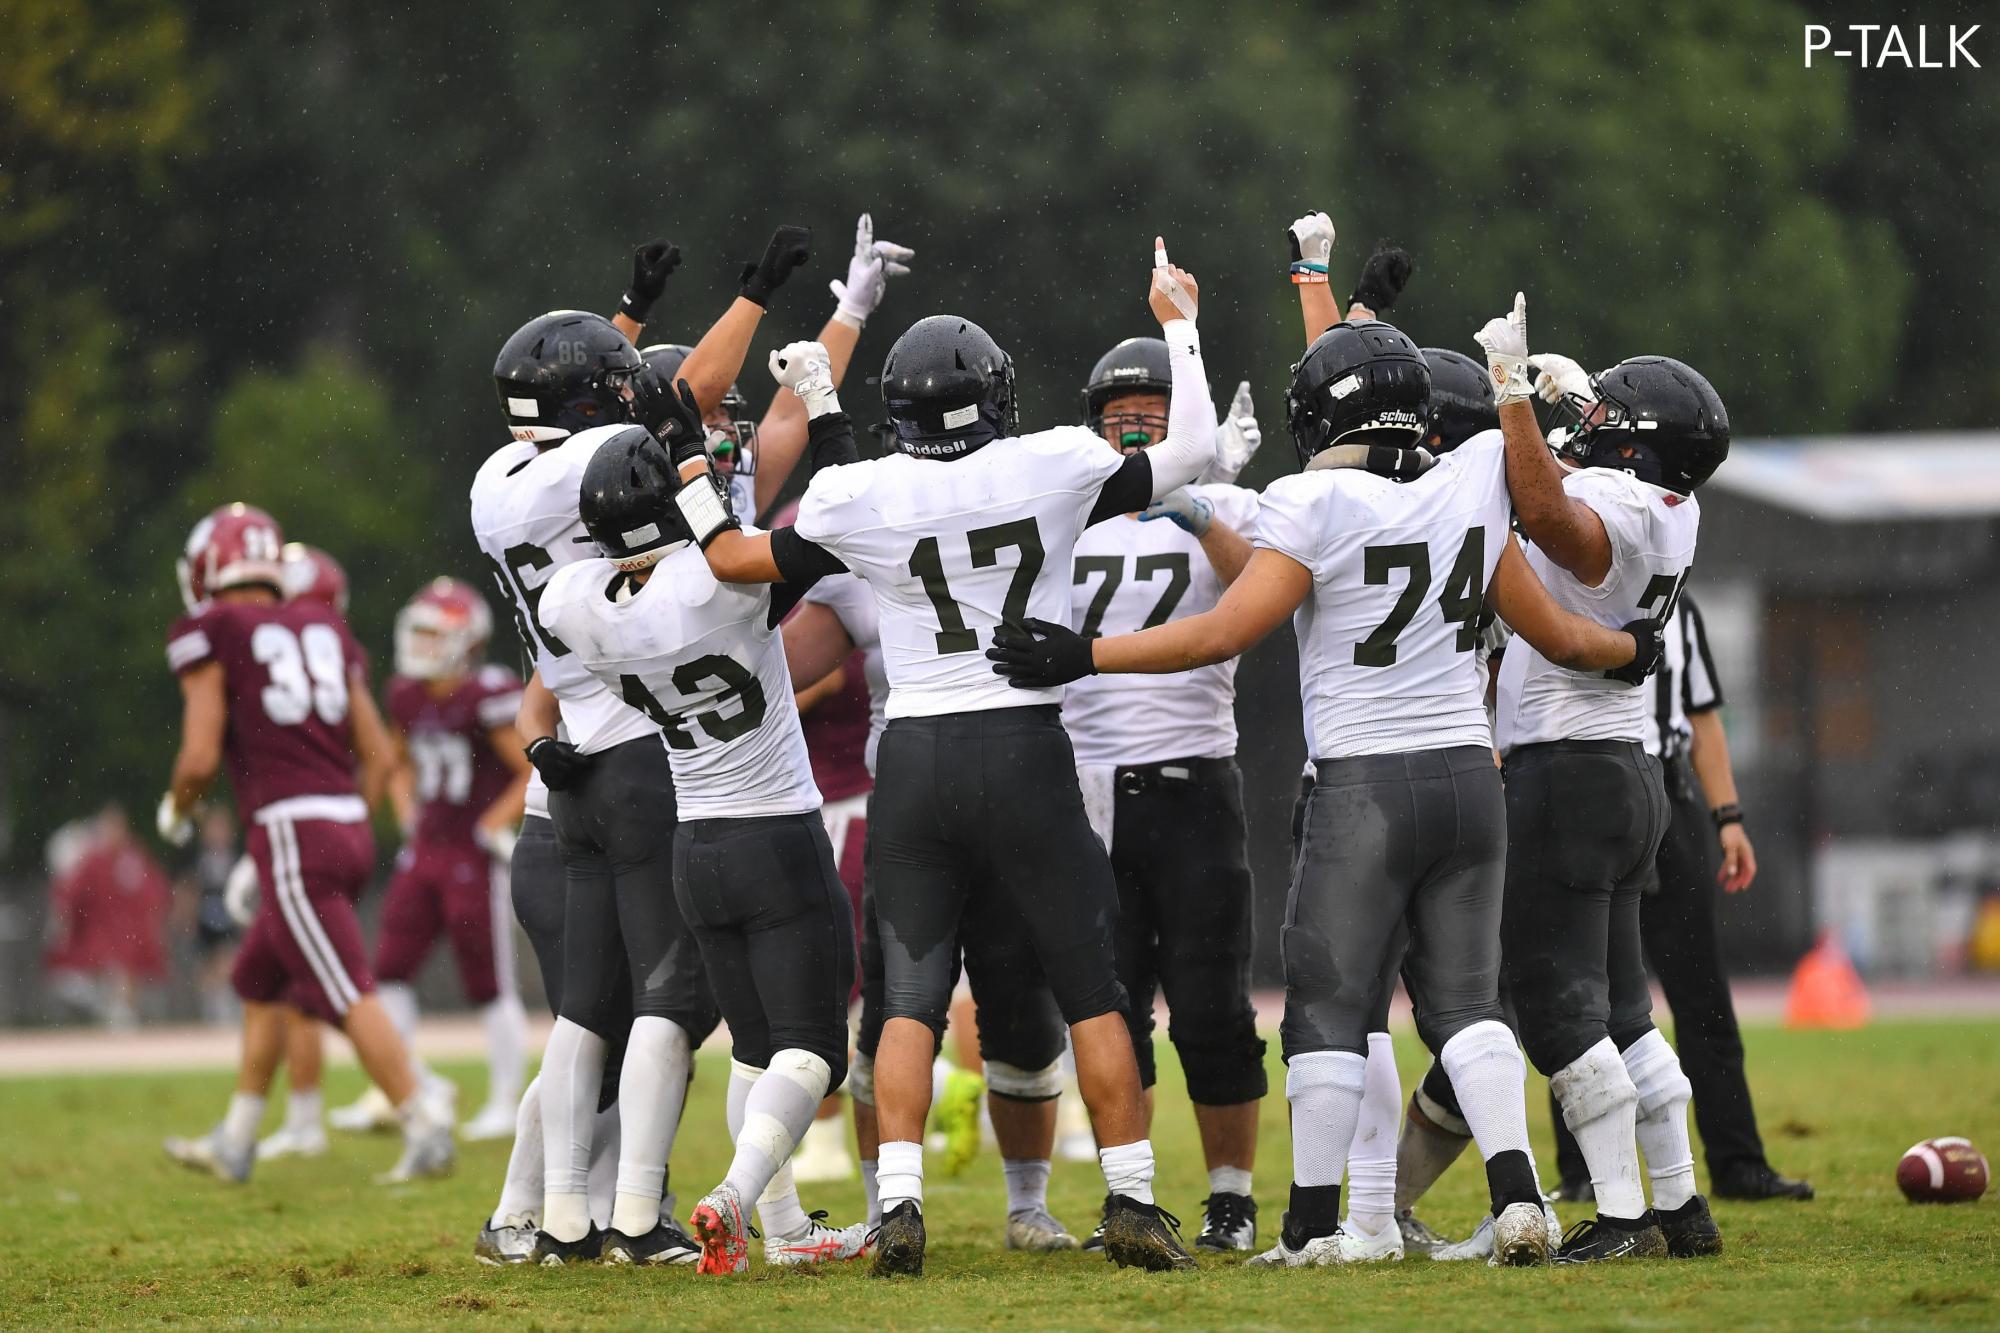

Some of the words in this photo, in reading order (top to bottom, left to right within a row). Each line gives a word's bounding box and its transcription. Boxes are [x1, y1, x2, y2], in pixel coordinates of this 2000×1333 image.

[559, 341, 587, 365] 86
[903, 440, 968, 455] Riddell
[908, 516, 1045, 655] 17
[1073, 552, 1191, 638] 77
[1353, 525, 1485, 668] 74
[251, 623, 349, 726] 39
